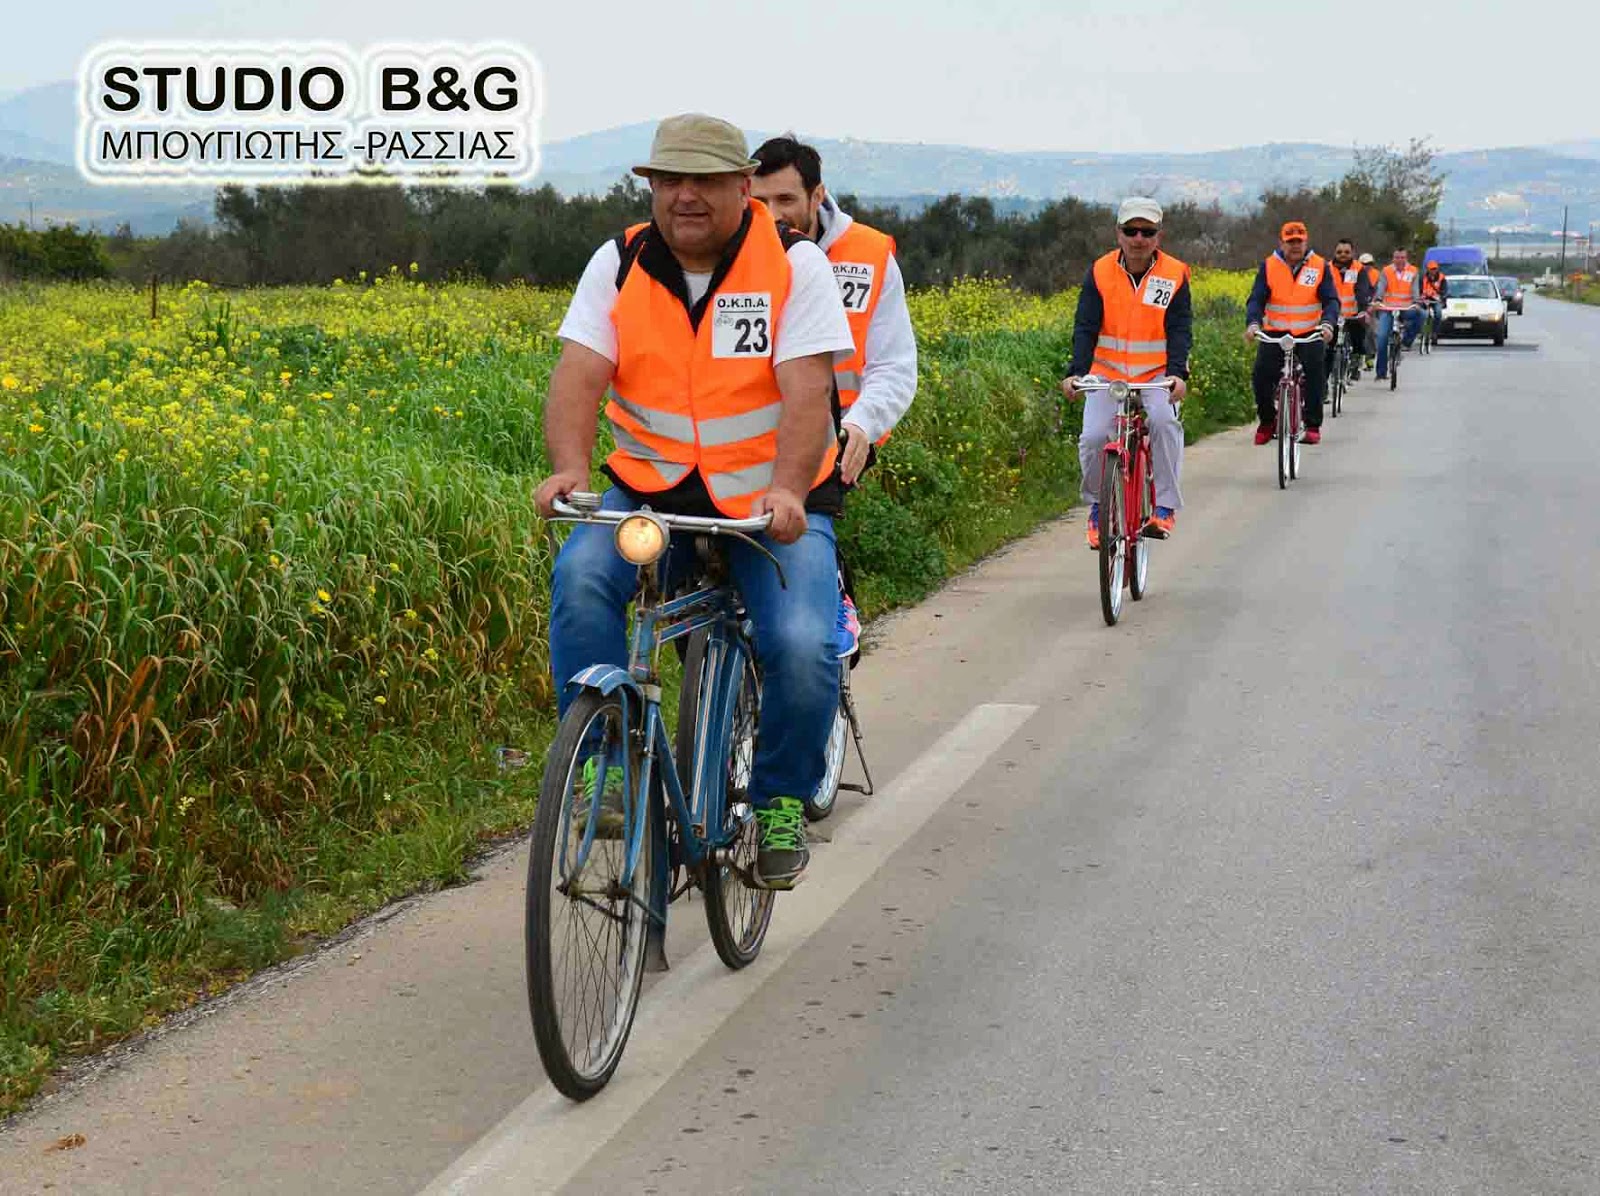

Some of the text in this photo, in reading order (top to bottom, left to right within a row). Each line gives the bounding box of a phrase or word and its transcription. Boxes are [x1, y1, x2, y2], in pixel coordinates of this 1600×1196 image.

[717, 298, 768, 308] Ο.Κ.Π.Α.
[842, 281, 870, 308] 27
[1153, 289, 1171, 306] 28
[734, 317, 768, 353] 23
